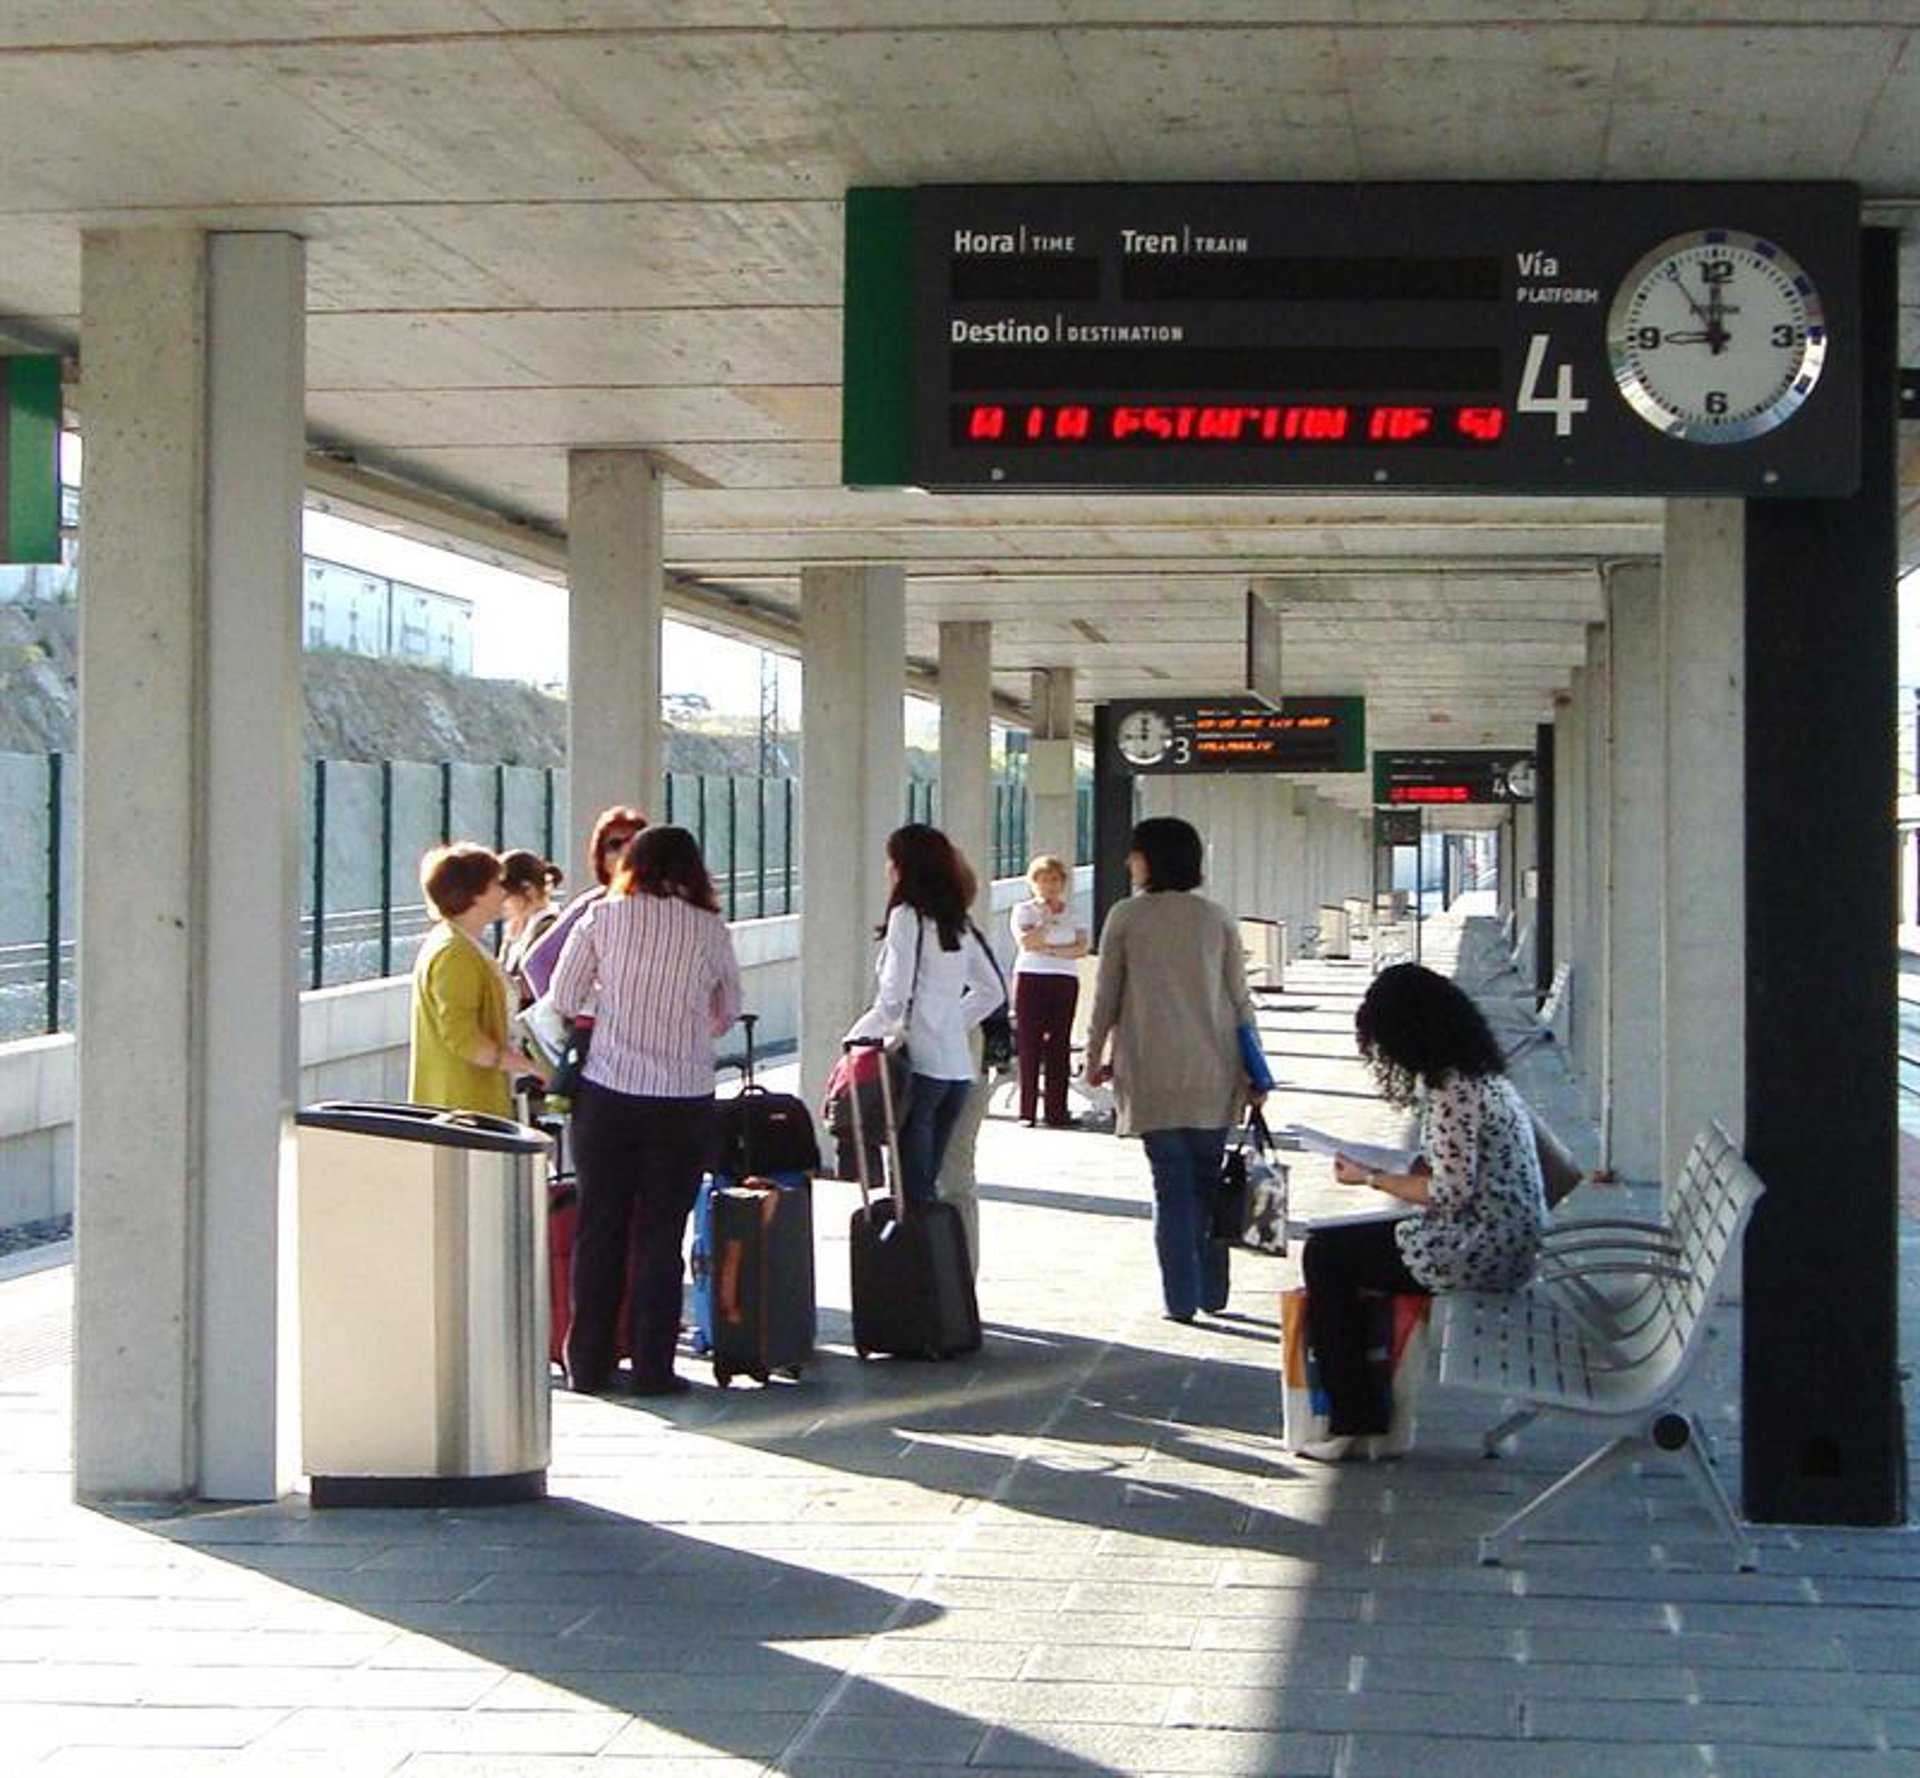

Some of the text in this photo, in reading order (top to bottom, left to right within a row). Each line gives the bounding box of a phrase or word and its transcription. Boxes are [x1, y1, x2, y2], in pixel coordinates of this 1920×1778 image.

[954, 230, 1075, 253] Hora TIME
[1121, 229, 1248, 253] Tren TRAIN
[1517, 250, 1558, 277] Vía
[1699, 260, 1735, 283] 12
[1517, 287, 1599, 304] PLATFORM
[951, 318, 1184, 343] Destino DESTINATION
[1639, 327, 1661, 350] 9
[1772, 325, 1794, 348] 3
[1516, 334, 1589, 437] 4
[1705, 391, 1728, 414] 6
[1174, 737, 1190, 765] 3
[1492, 778, 1507, 797] 4
